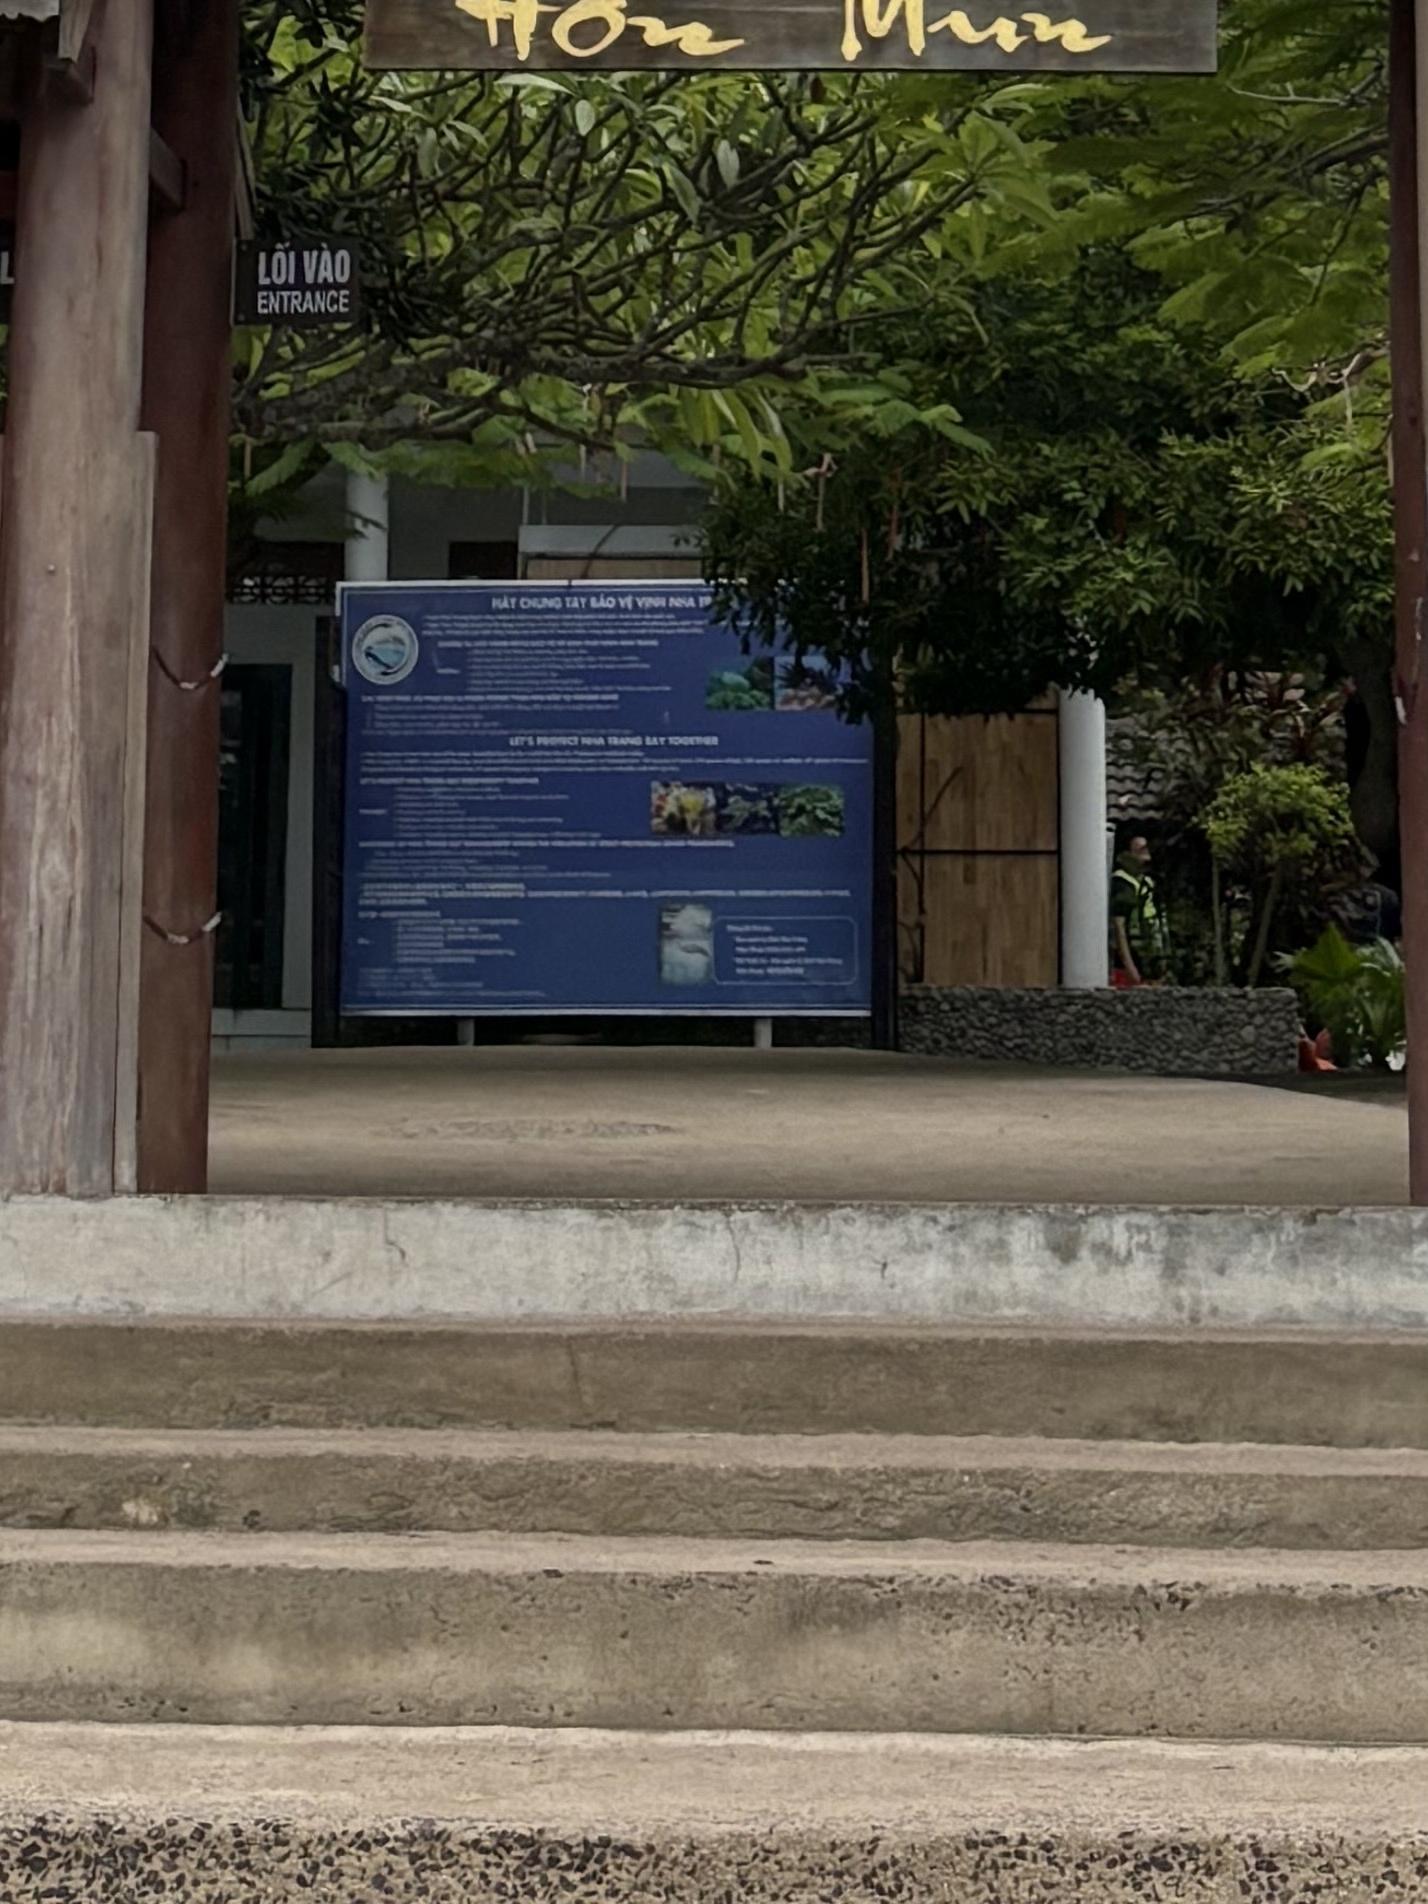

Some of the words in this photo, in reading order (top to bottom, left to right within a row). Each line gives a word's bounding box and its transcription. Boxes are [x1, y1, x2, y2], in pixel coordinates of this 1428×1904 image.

[257, 241, 297, 286] LỐI
[302, 242, 352, 285] VÀO
[256, 289, 351, 315] ENTRANCE
[564, 596, 587, 610] TAY
